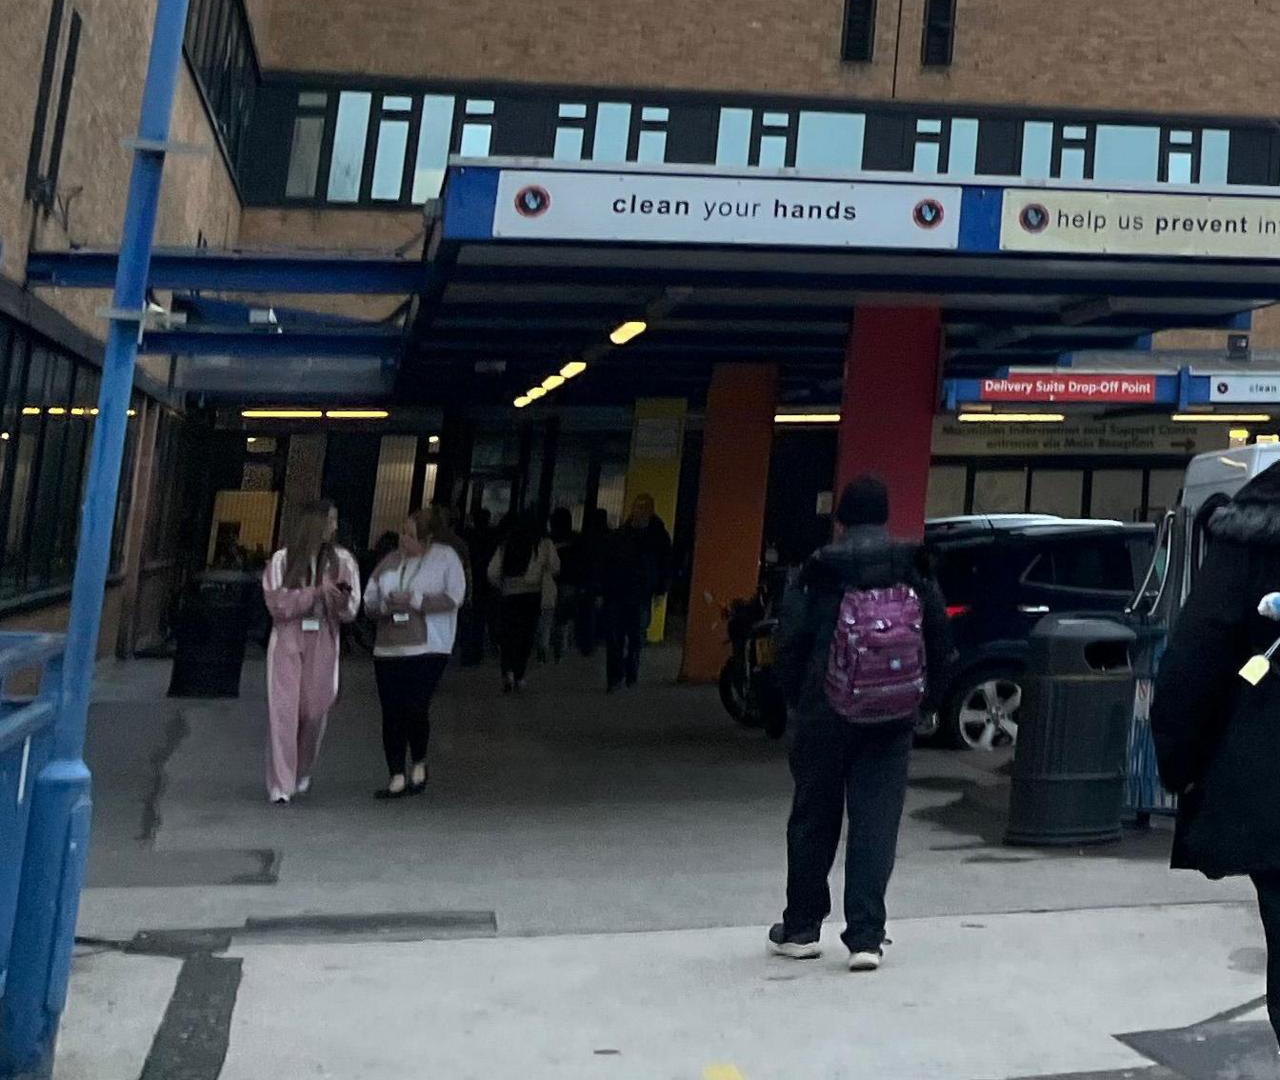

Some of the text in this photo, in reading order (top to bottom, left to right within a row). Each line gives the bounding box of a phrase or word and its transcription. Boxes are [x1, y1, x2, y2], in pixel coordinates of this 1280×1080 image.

[612, 194, 857, 222] clean your hands
[1057, 209, 1107, 234] help
[1118, 215, 1144, 231] us
[1155, 216, 1248, 237] prevent
[984, 379, 1151, 397] Delivery Suite Drop-Off Point
